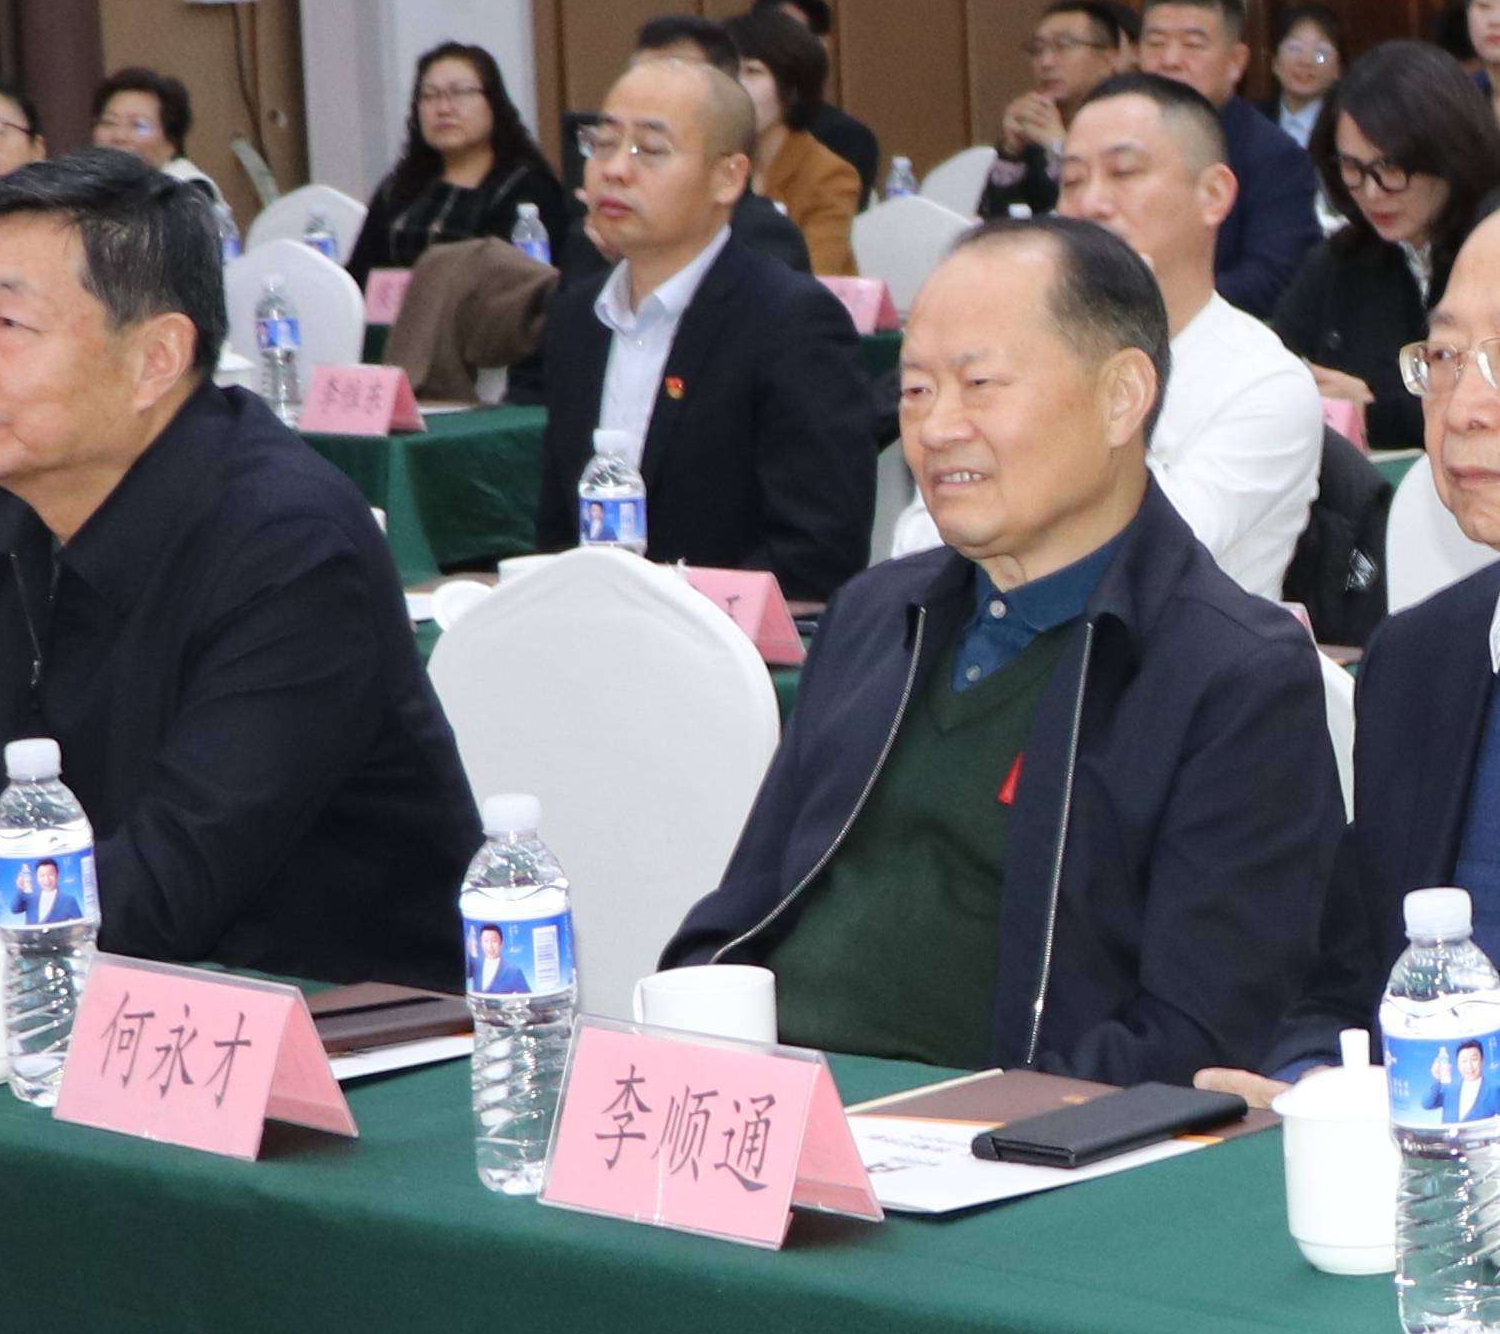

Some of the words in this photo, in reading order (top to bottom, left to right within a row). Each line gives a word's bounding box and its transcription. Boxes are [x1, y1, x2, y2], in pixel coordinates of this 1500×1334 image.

[100, 991, 253, 1109] 何永才
[594, 1064, 777, 1192] 李顺通
